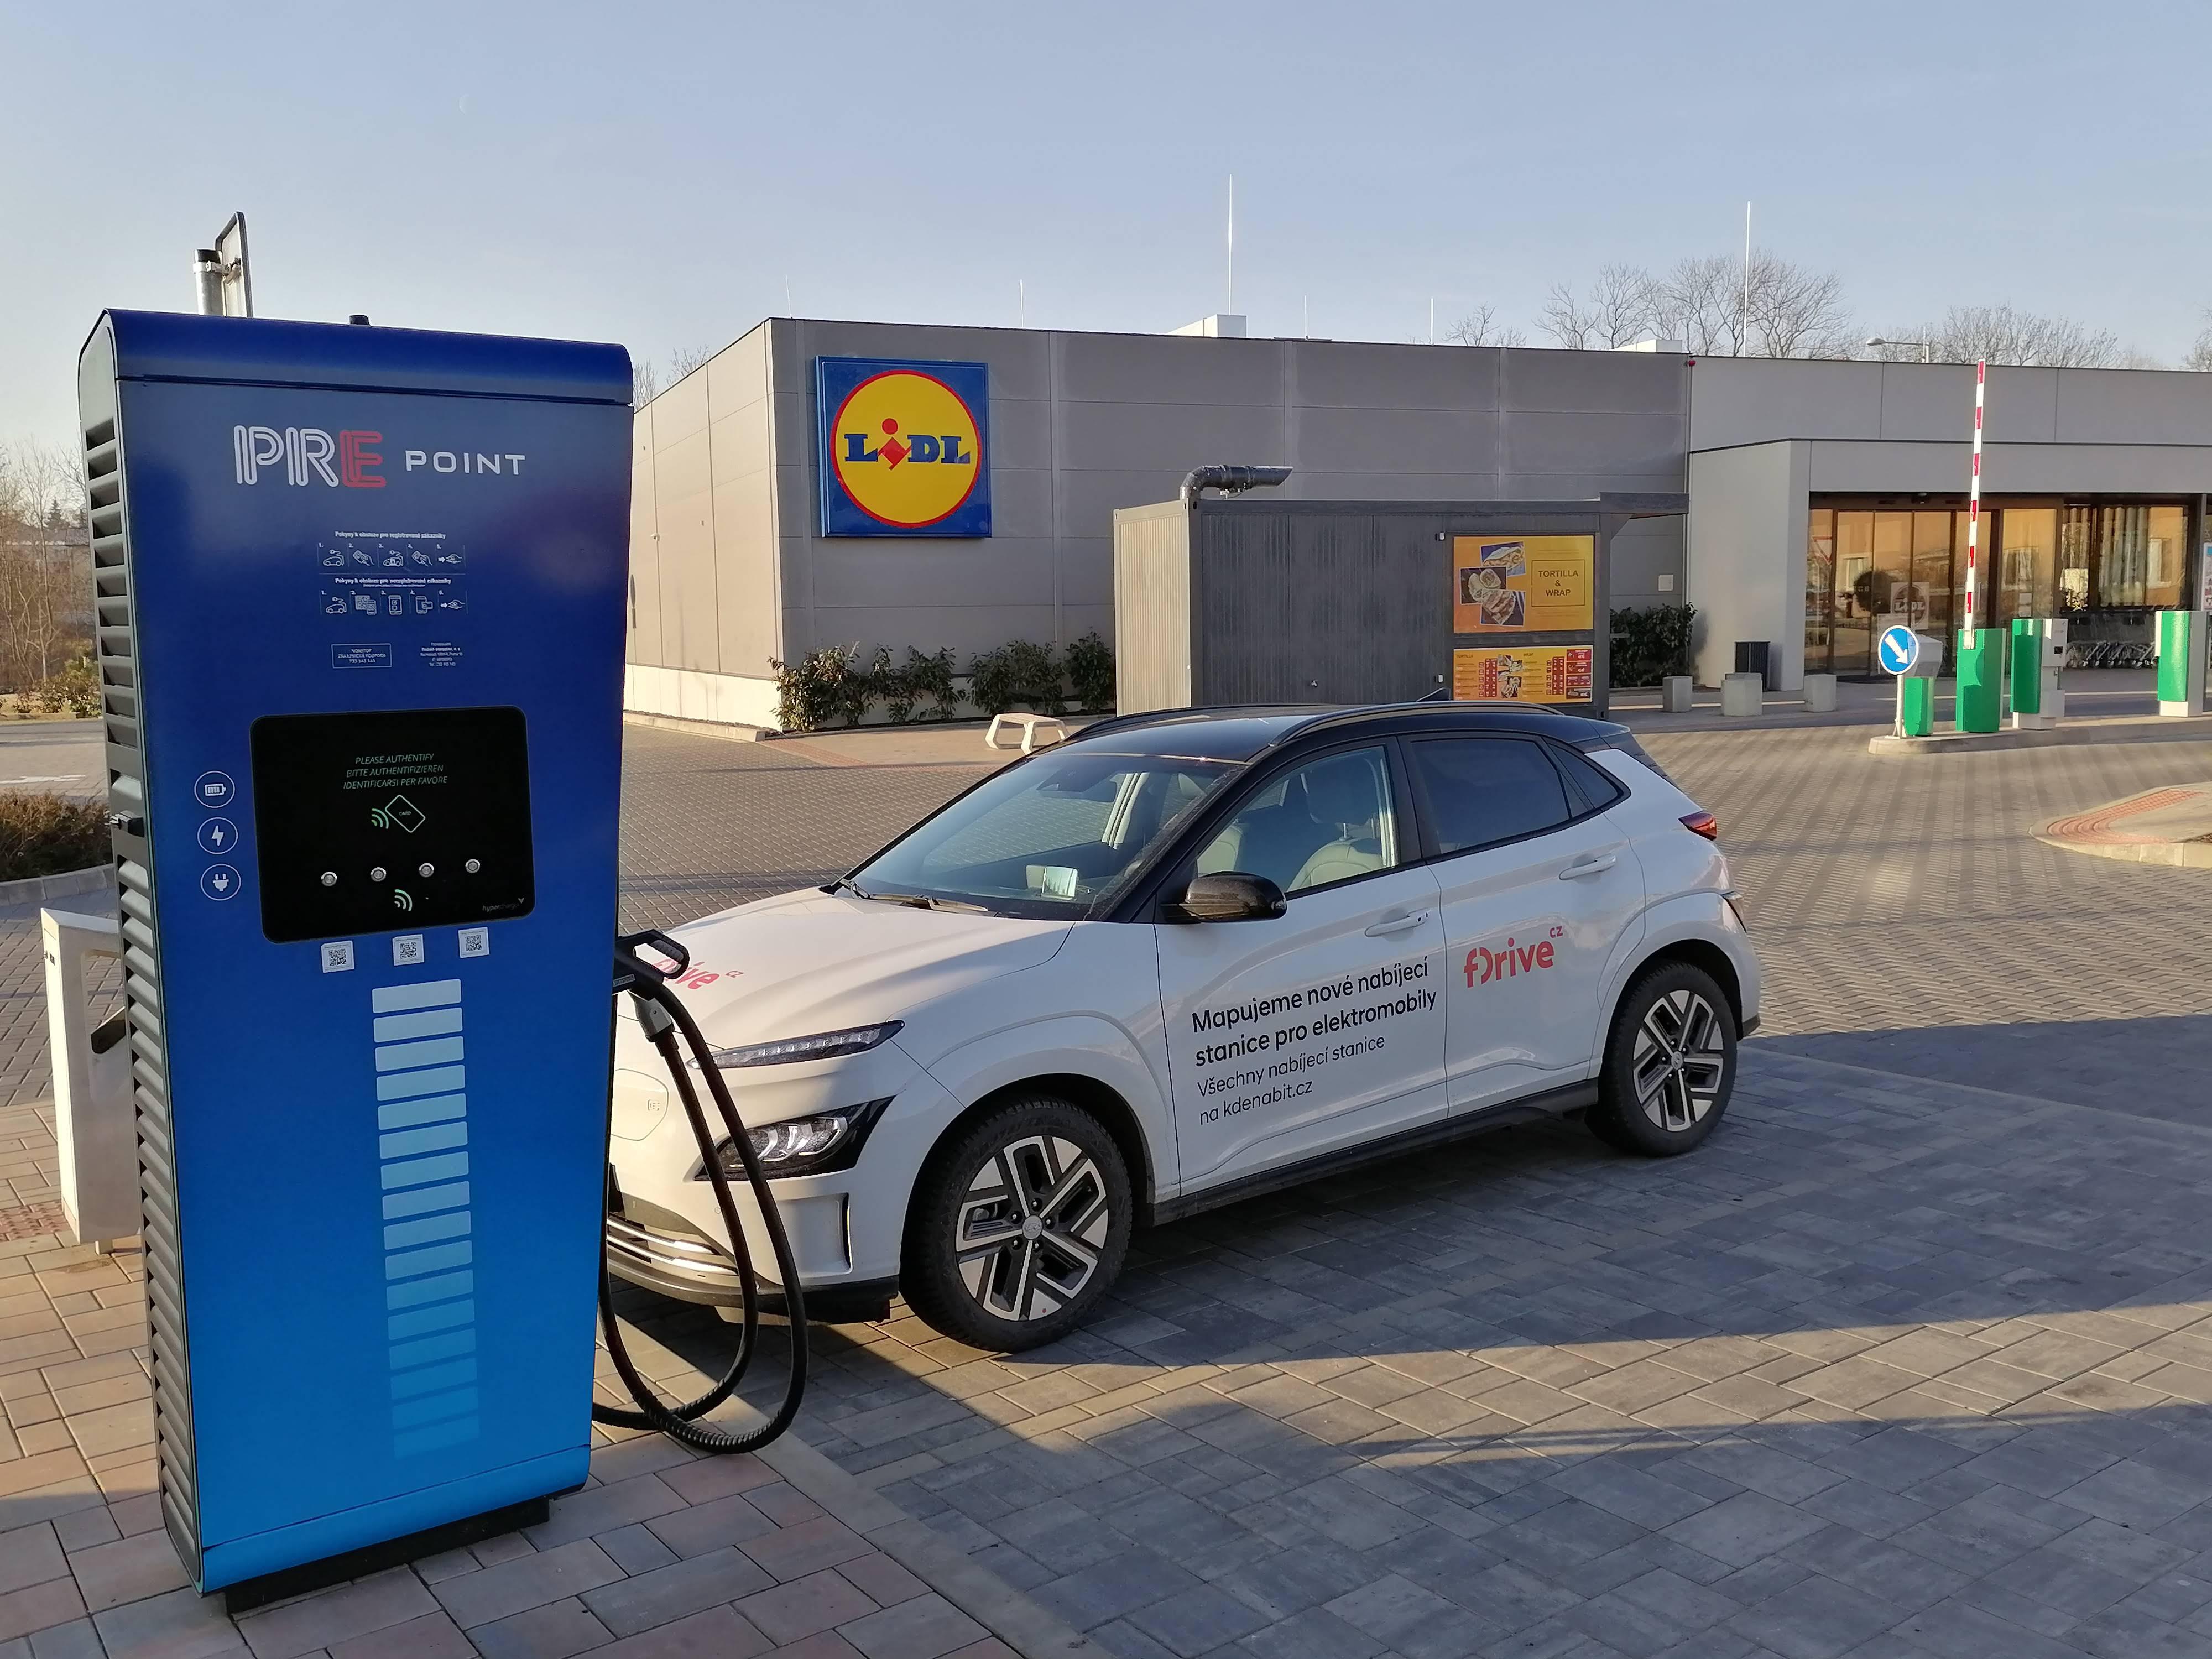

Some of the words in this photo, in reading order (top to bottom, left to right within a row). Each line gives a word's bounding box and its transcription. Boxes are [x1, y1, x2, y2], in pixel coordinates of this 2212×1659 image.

[233, 425, 387, 487] PRE
[405, 450, 525, 475] POINT
[844, 418, 971, 470] LIDL
[343, 780, 398, 789] IDENTIFICARSI
[418, 776, 448, 785] FAVORE
[346, 769, 369, 778] BITTE
[371, 765, 444, 776] AUTHENTIFIZIEREN
[356, 756, 385, 764] PLEASE
[386, 753, 434, 763] AUTHENTIFY
[1192, 993, 1302, 1033] Mapujeme
[1307, 975, 1353, 1005] nové
[1358, 956, 1428, 993] nabíjecí
[1196, 1034, 1270, 1067] stanice
[1275, 1025, 1307, 1051] pro
[1313, 989, 1437, 1036] elektromobily
[1197, 1068, 1264, 1097] Všechny
[1269, 1047, 1328, 1078] nabíjecí
[1332, 1036, 1385, 1061] stanice
[1199, 1108, 1219, 1125] na
[1223, 1081, 1313, 1118] kdenabit.cz
